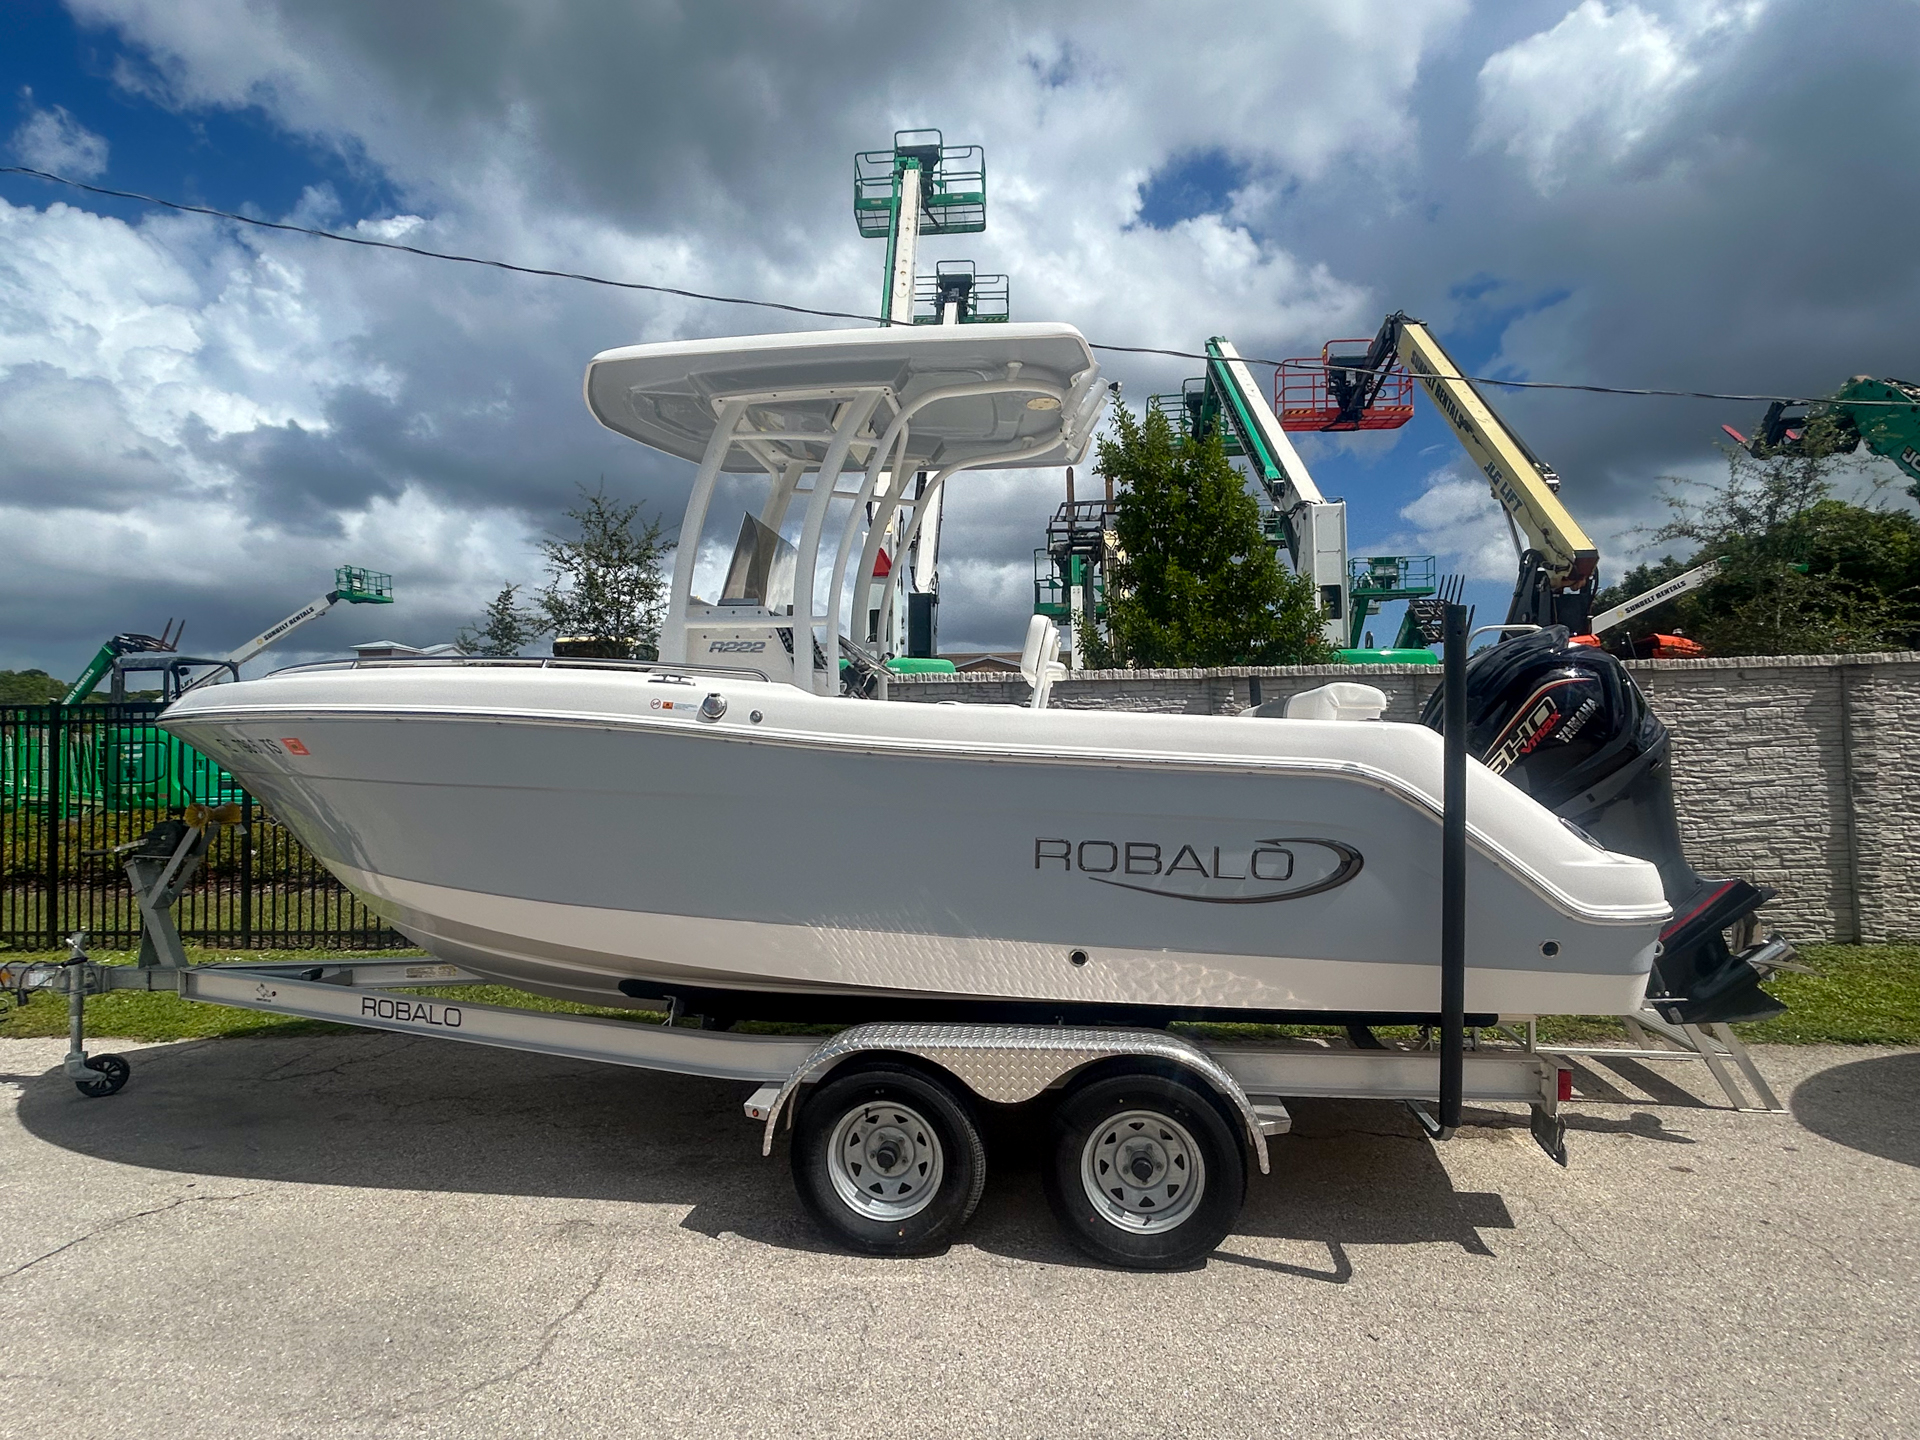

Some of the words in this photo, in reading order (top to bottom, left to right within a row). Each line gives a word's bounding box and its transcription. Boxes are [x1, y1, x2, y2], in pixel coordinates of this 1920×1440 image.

[1434, 380, 1464, 430] RENTALS
[1484, 461, 1502, 486] JLG
[1500, 481, 1523, 512] LIFT
[1625, 595, 1655, 613] SUNBELT
[1655, 580, 1687, 599] RENTALS
[263, 622, 289, 640] SUNBELT
[288, 606, 315, 625] RENTALS
[709, 641, 766, 653] R222
[1555, 698, 1599, 743] YAMAHA
[1034, 837, 1294, 881] ROBALO
[361, 996, 462, 1027] ROBALO
